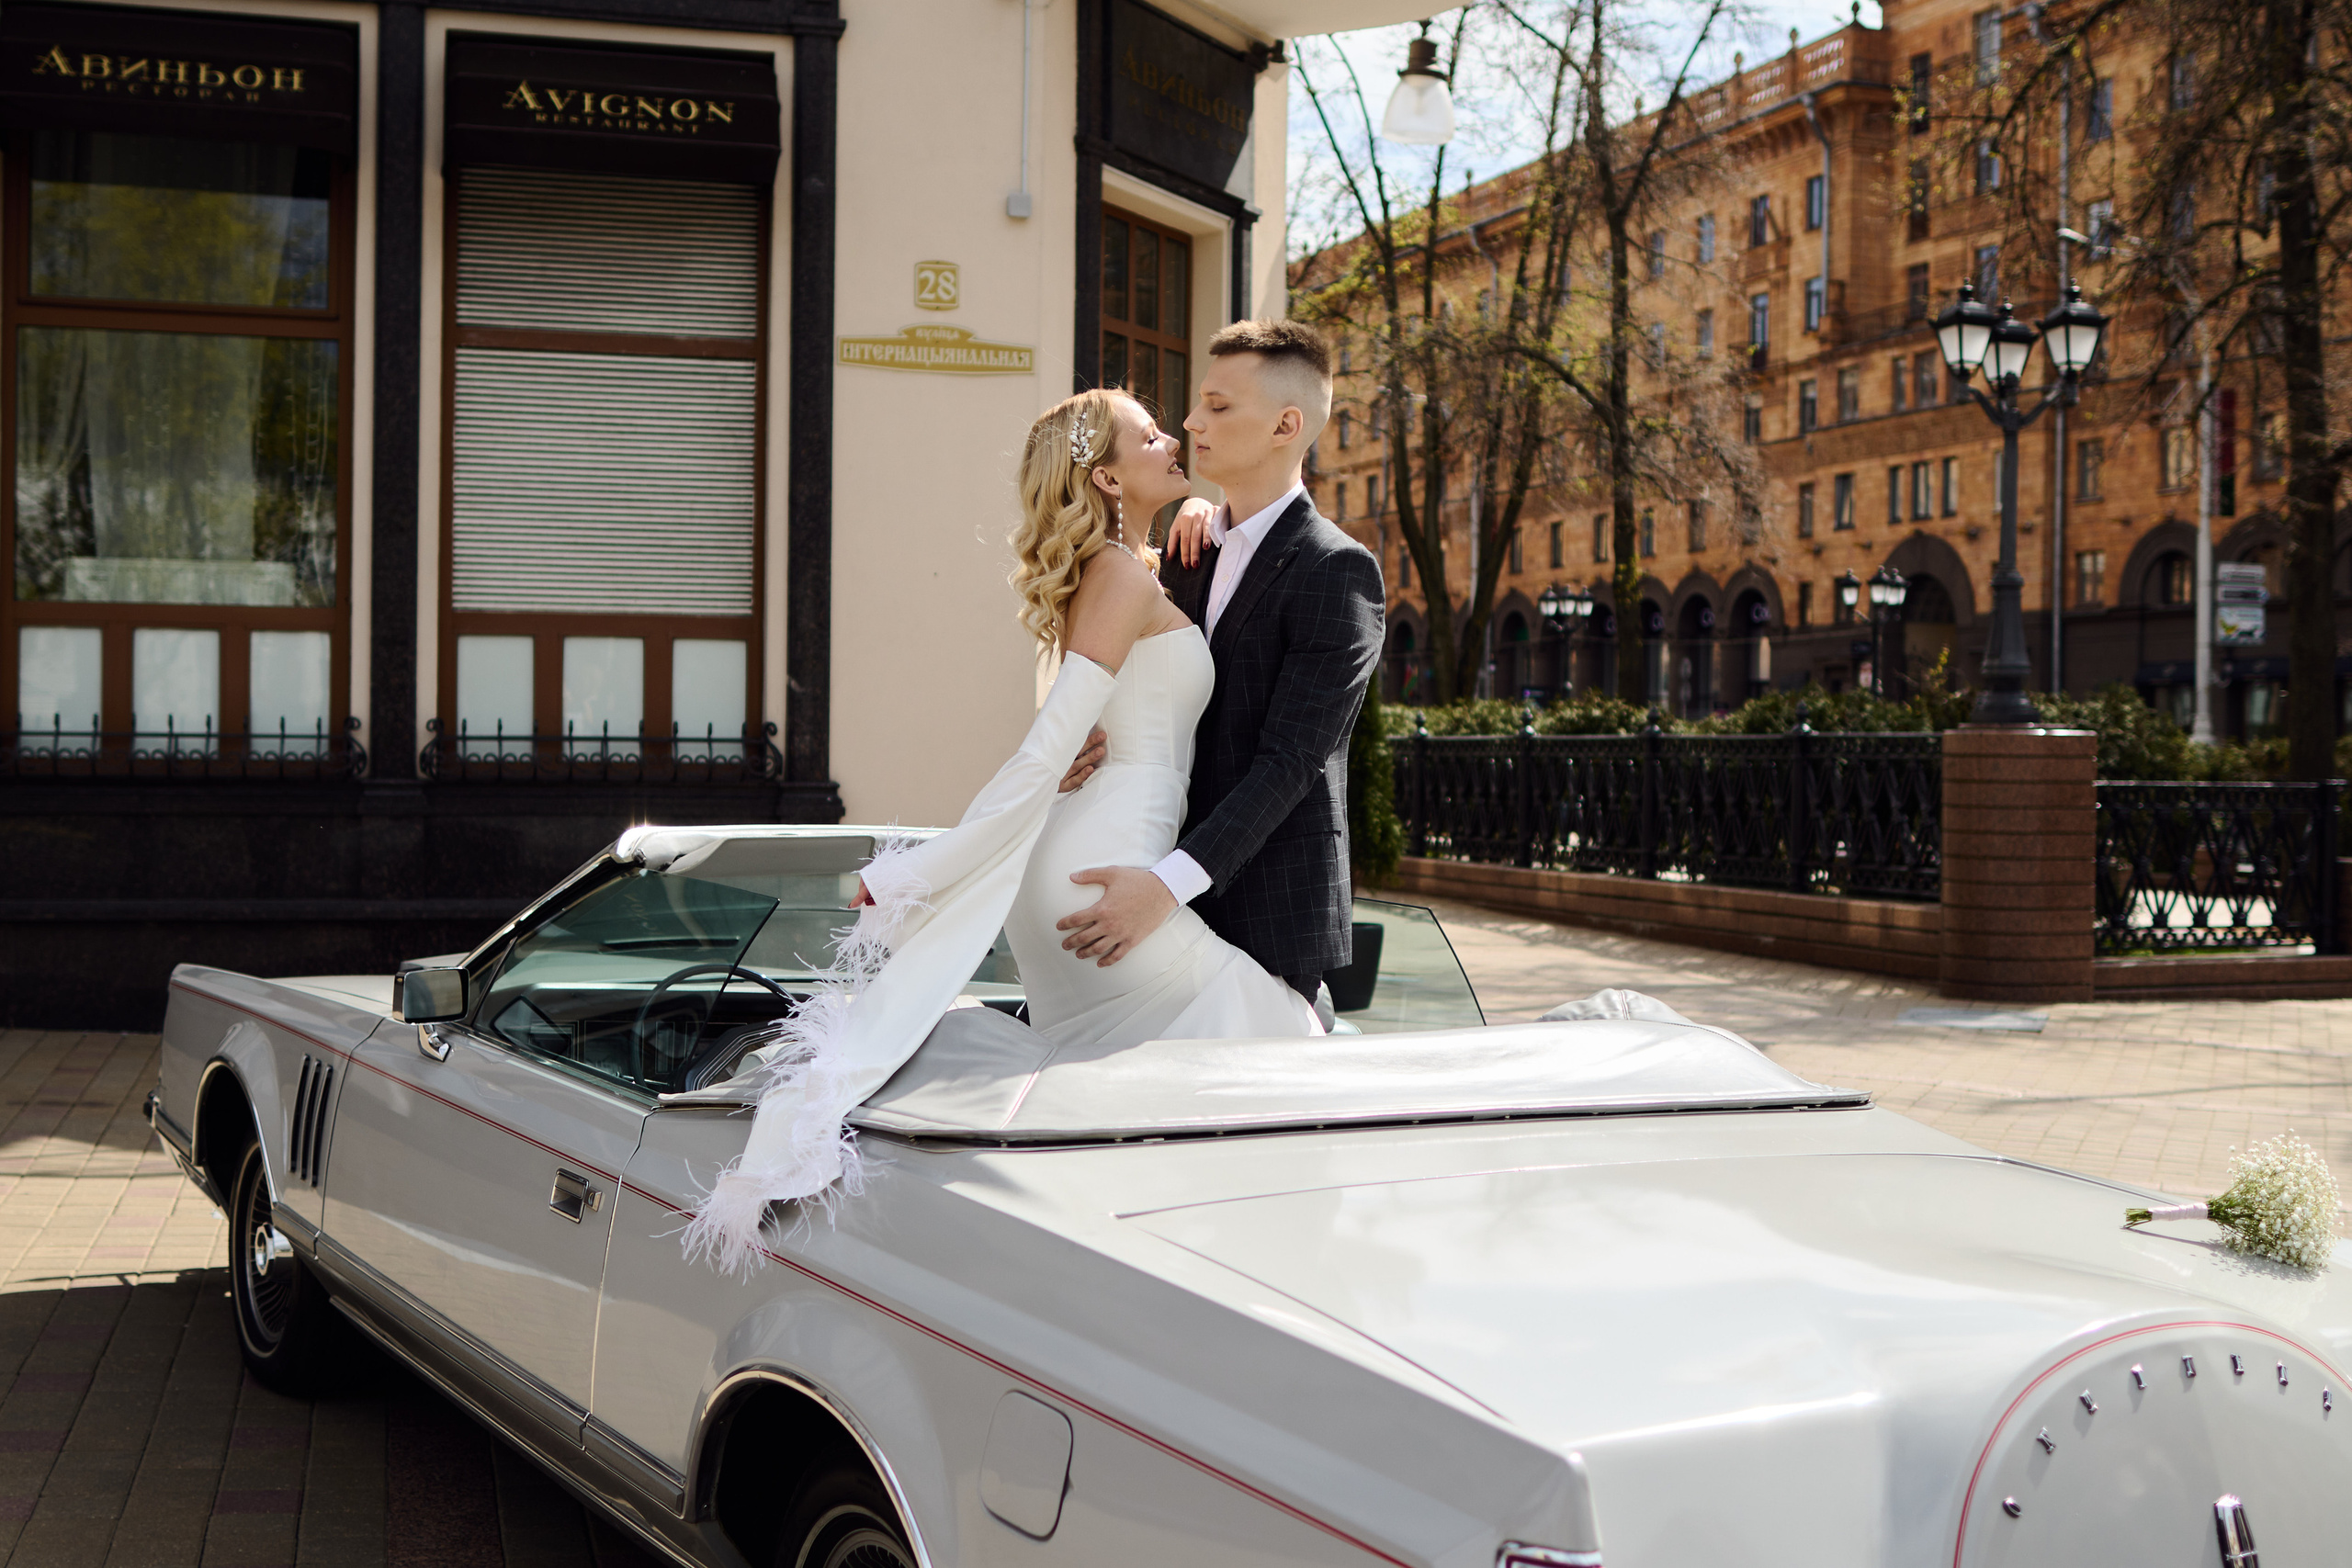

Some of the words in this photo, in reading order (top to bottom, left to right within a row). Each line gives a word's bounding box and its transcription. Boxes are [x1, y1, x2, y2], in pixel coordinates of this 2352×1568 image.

[31, 45, 307, 92] АВИНЬОН
[502, 79, 735, 124] AVIGNON
[919, 269, 956, 301] 28
